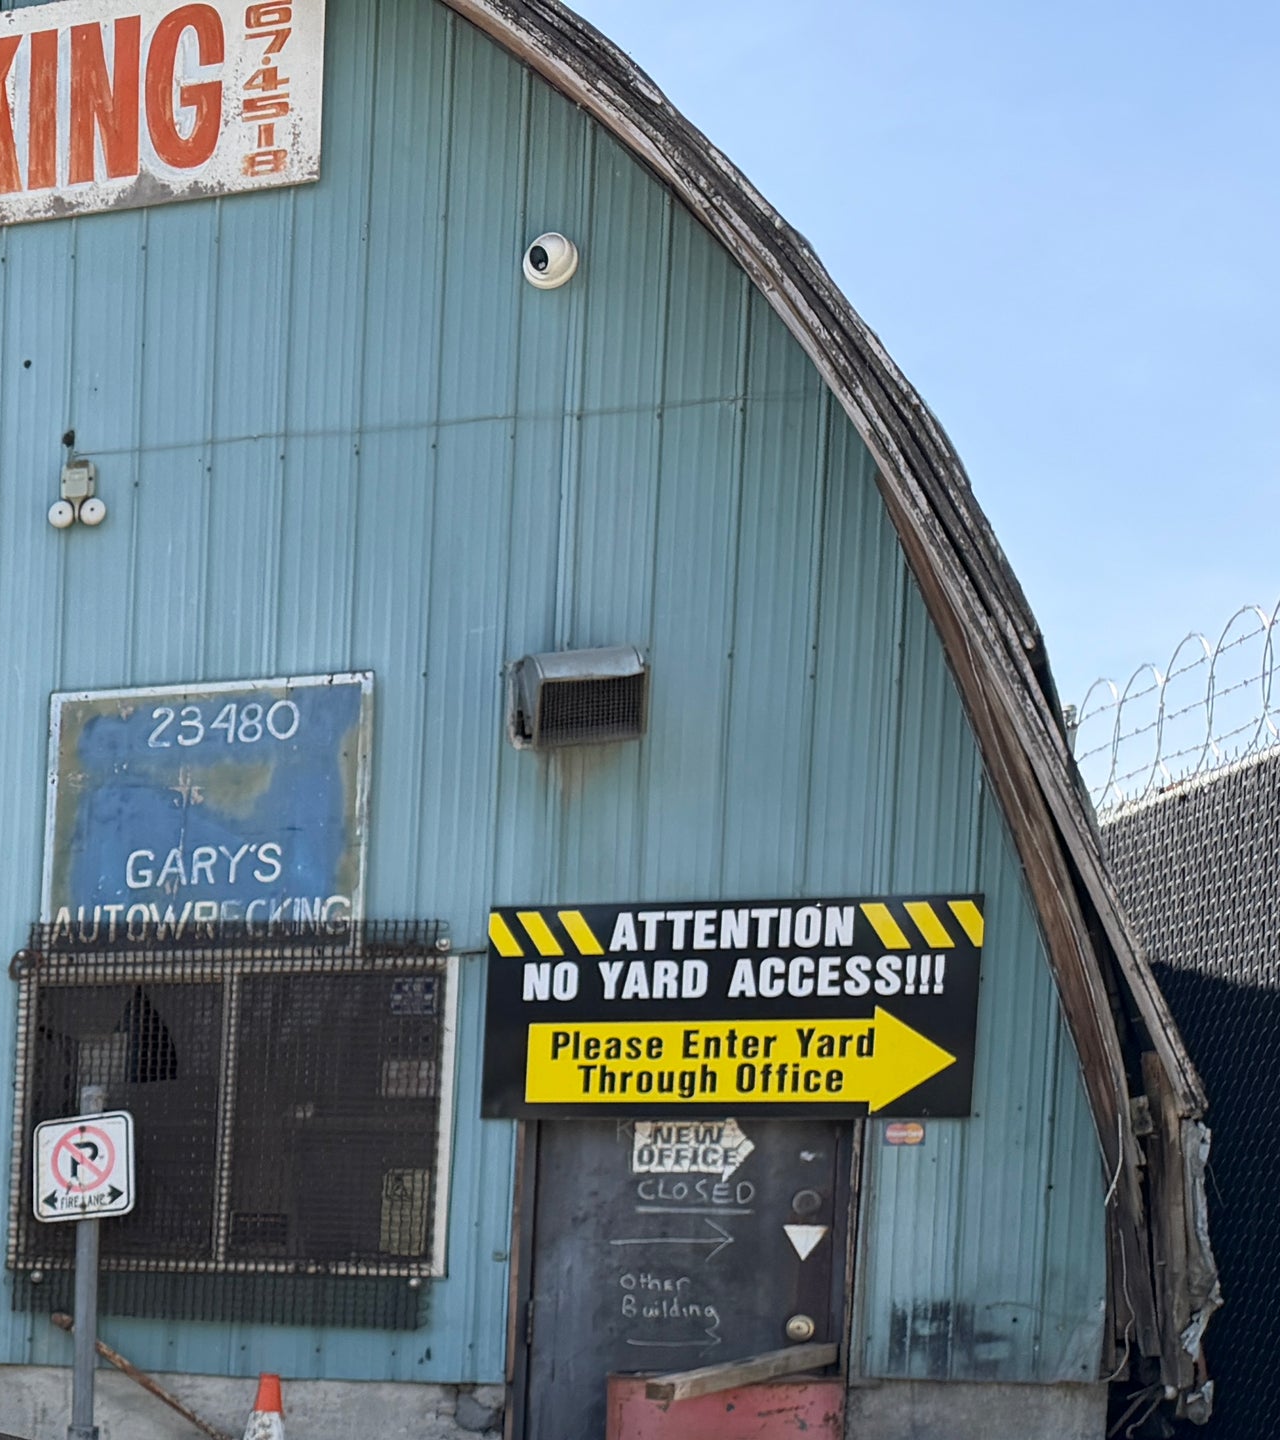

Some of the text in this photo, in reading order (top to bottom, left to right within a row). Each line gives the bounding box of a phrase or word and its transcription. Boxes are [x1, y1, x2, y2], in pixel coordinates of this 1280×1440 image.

[147, 699, 301, 748] 23480
[125, 841, 283, 889] GARY'S
[51, 895, 352, 945] AUTOWRECKING
[608, 904, 856, 952] ATTENTION
[522, 953, 947, 1002] NO YARD ACCESS!!!
[550, 1026, 876, 1061] Please Enter Yard
[577, 1062, 845, 1099] Through Office
[653, 1123, 723, 1145] NEW
[637, 1145, 739, 1167] OFFICE
[60, 1194, 80, 1211] FIRE
[637, 1179, 756, 1205] CLOSED
[621, 1293, 720, 1327] Building
